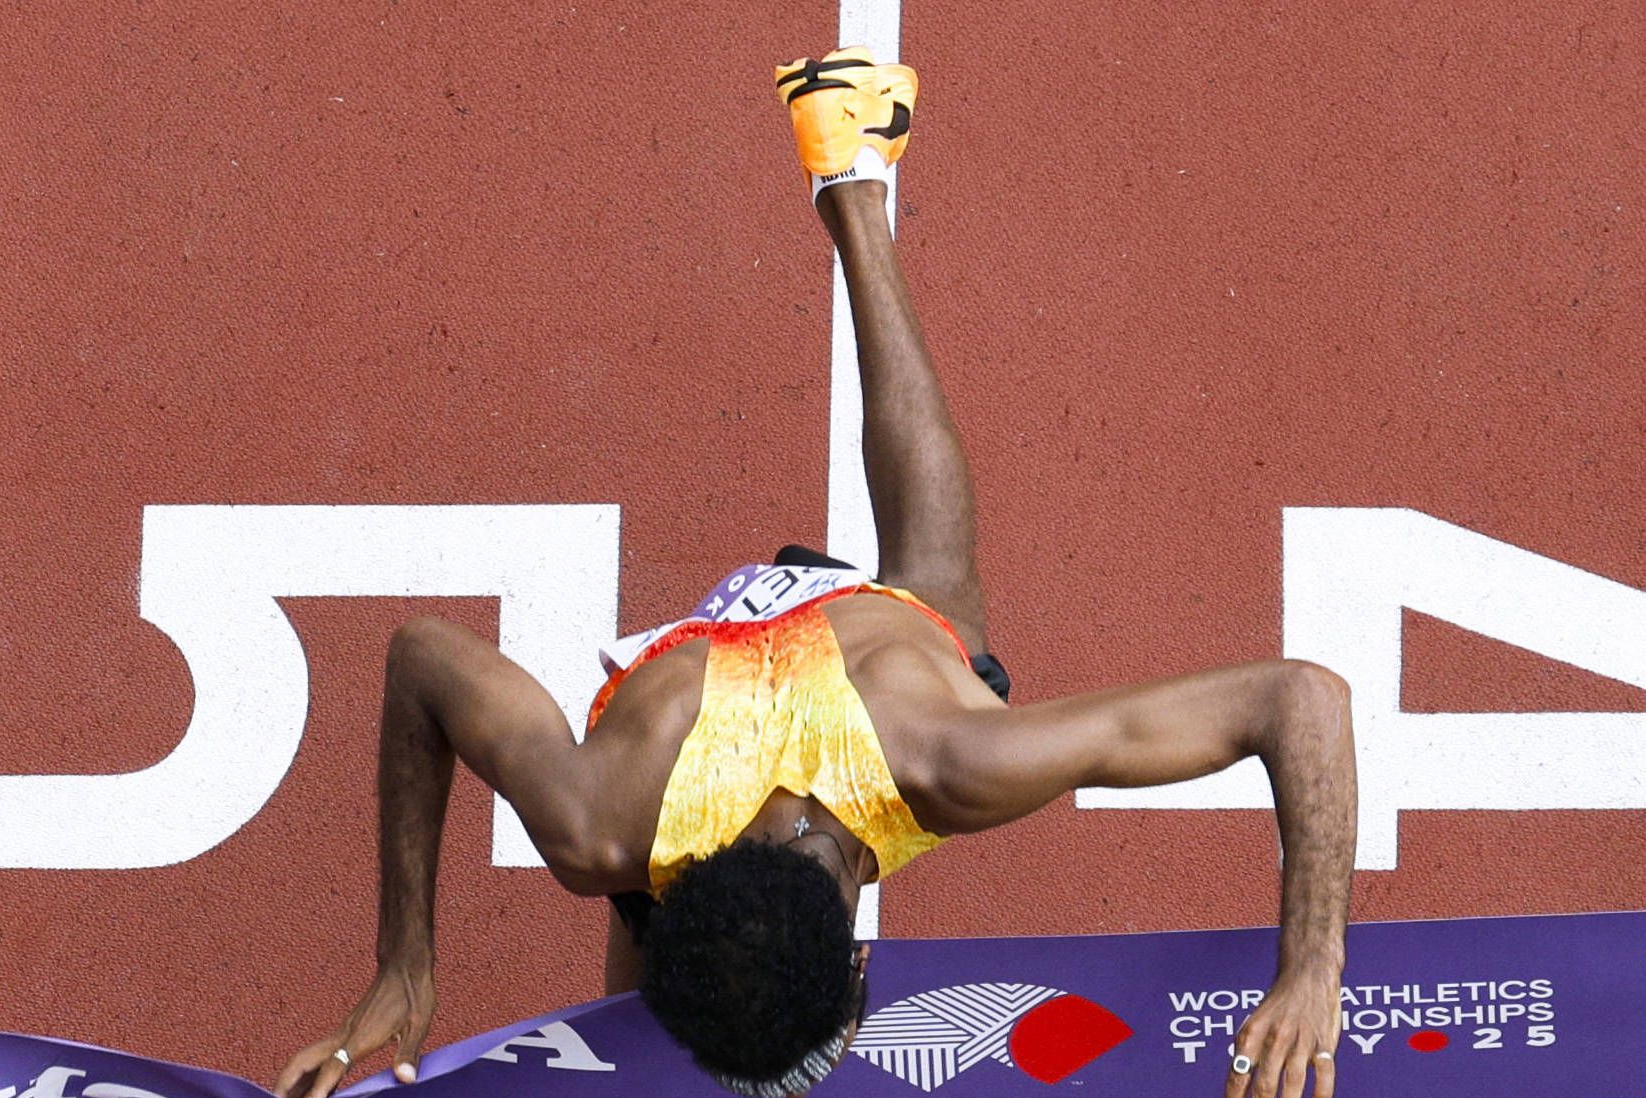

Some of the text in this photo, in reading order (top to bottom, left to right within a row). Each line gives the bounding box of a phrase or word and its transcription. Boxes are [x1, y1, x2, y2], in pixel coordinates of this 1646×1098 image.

[1168, 979, 1555, 1012] WOR ATHLETICS
[1169, 1002, 1555, 1039] CHIONSHIPS
